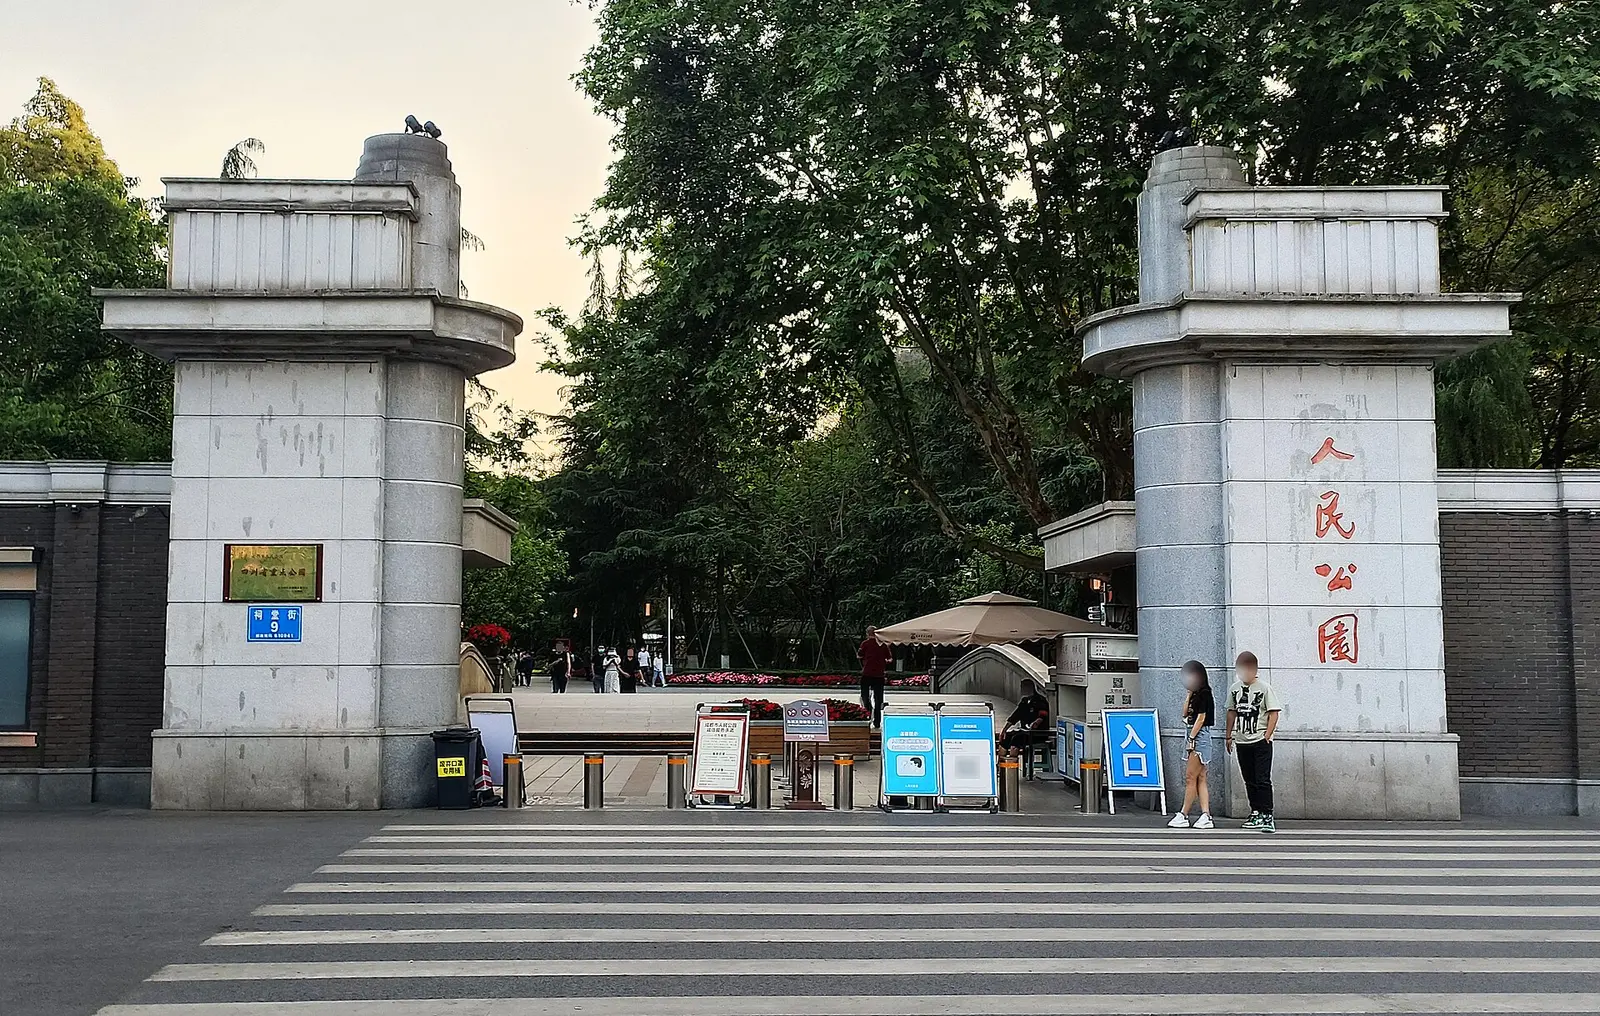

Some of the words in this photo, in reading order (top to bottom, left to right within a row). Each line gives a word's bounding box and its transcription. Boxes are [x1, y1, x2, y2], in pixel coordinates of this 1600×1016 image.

[1310, 437, 1358, 664] 人民公园
[254, 609, 297, 620] 祠堂街
[270, 621, 279, 633] 9
[1120, 724, 1147, 777] 入口
